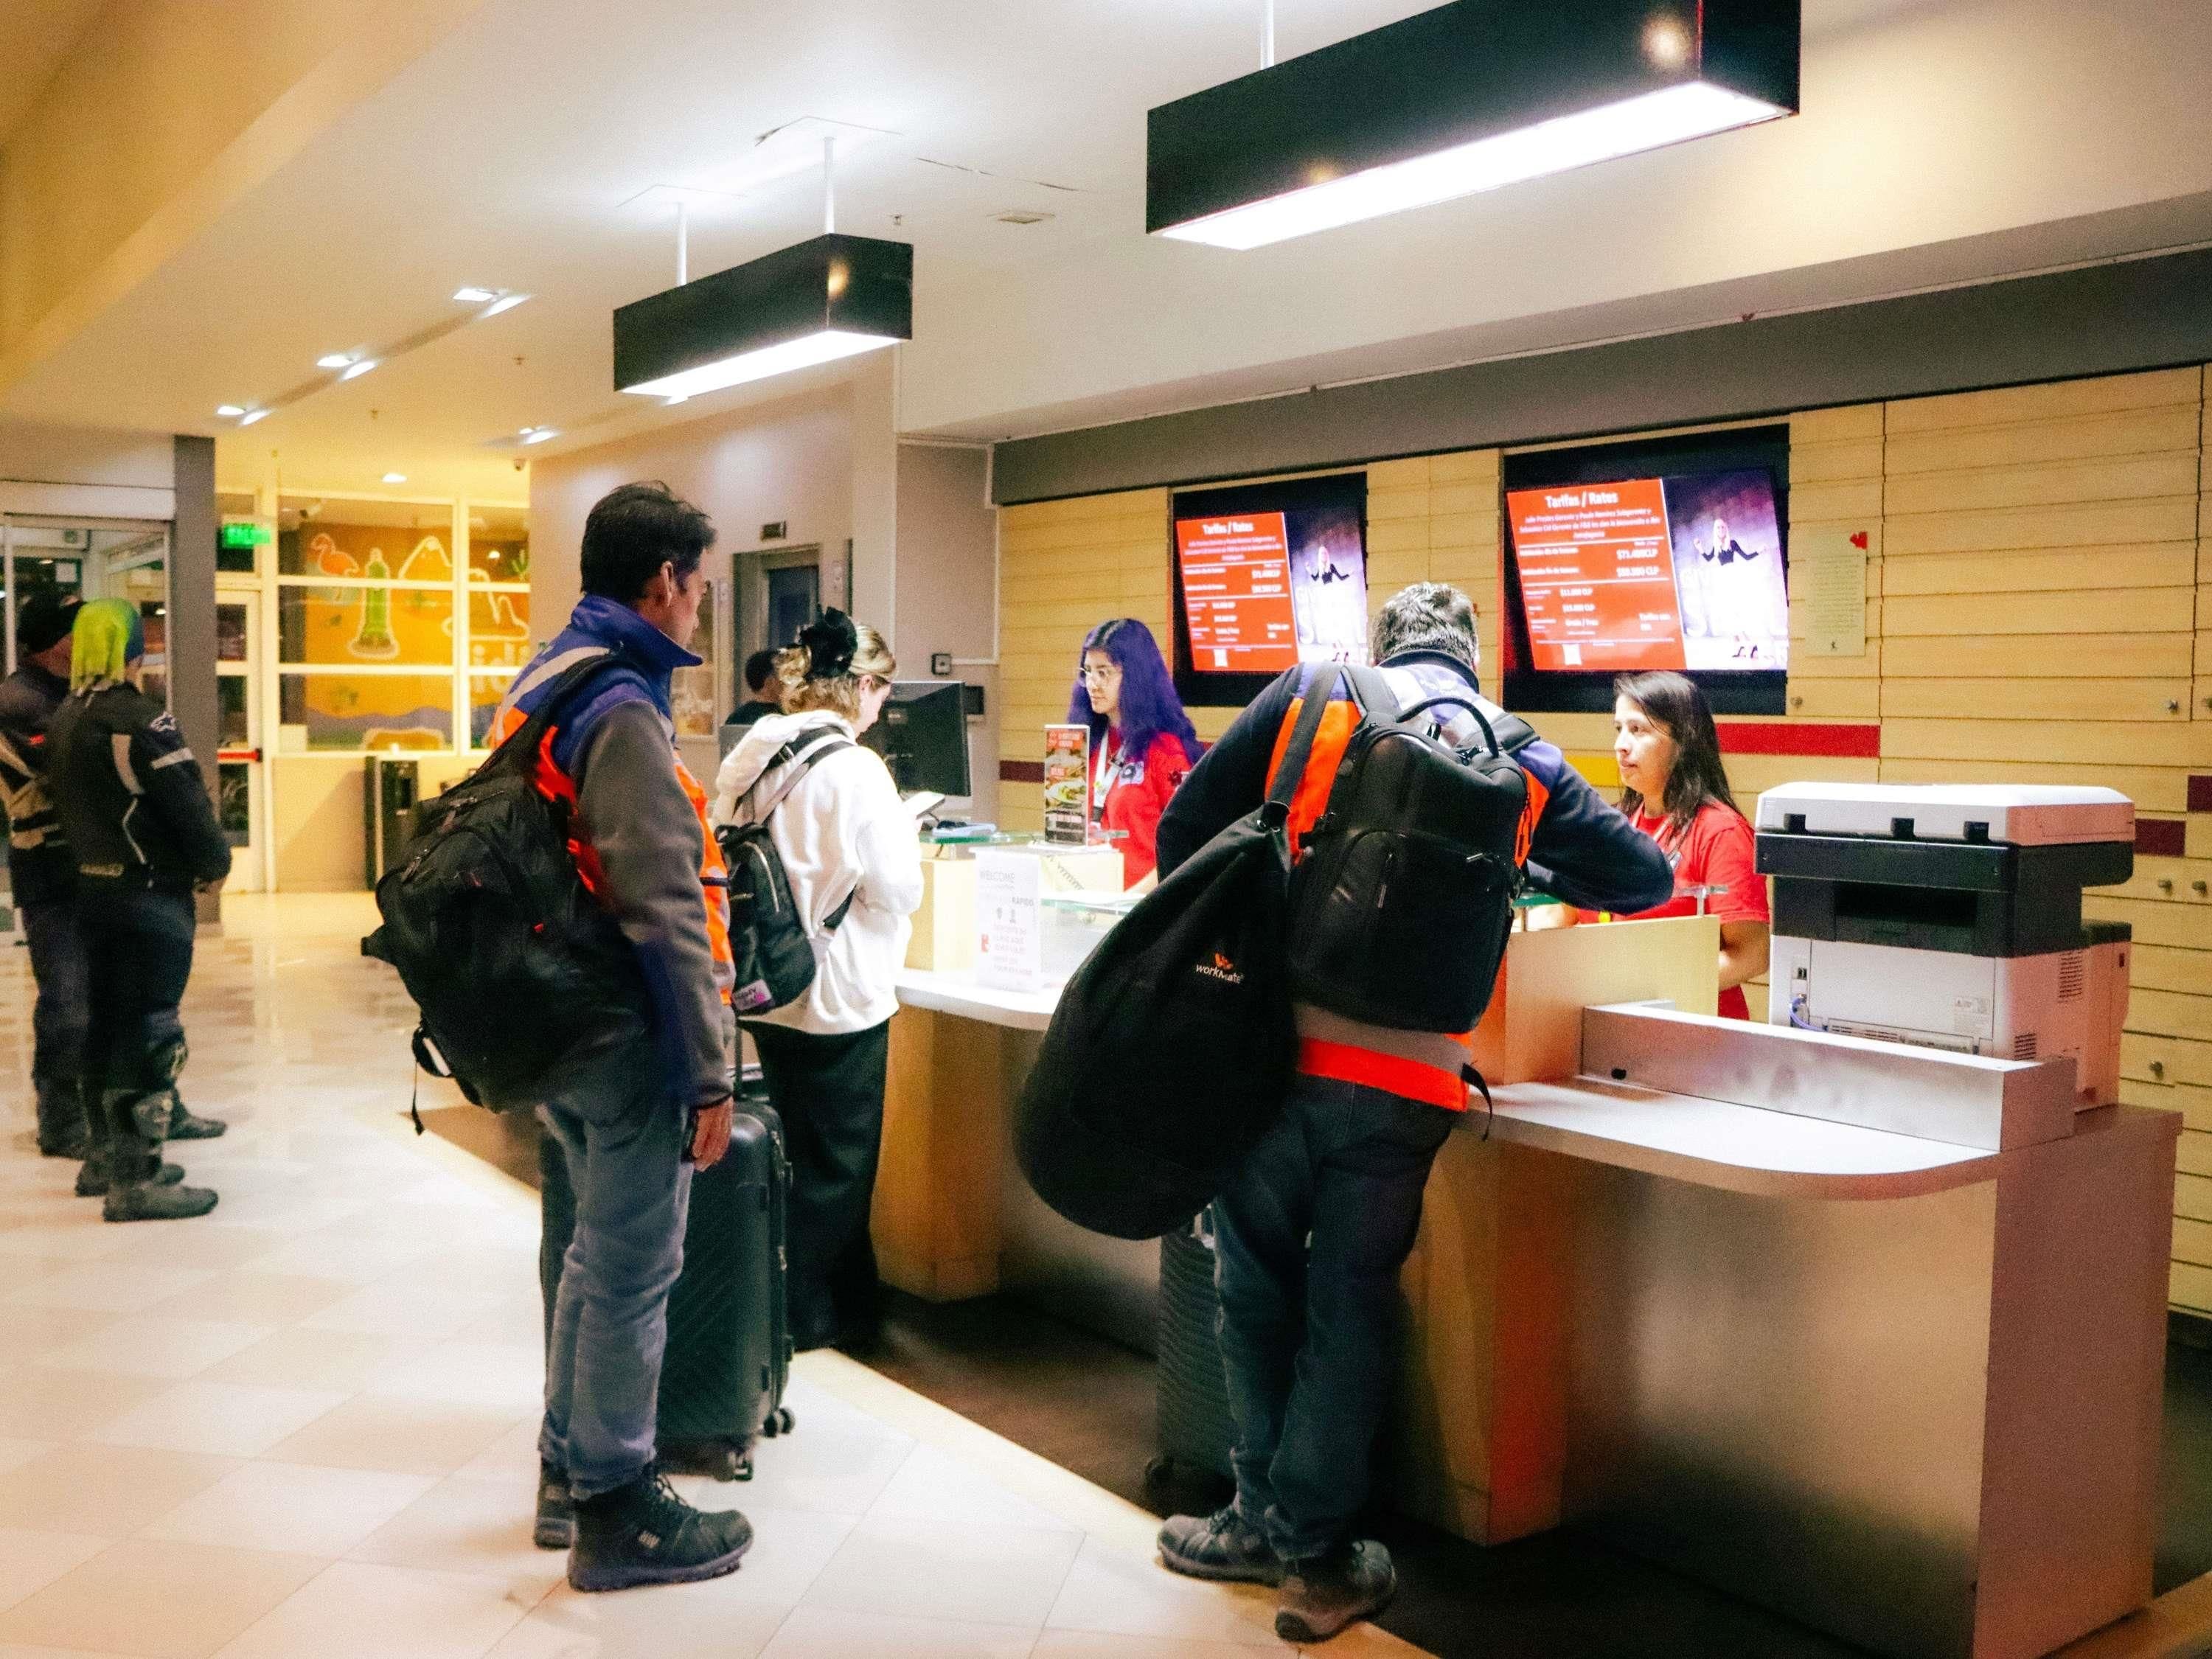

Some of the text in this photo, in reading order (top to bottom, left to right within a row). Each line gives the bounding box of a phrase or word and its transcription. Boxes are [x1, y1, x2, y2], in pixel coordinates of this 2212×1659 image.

[1545, 490, 1618, 508] Tarifas / Rates
